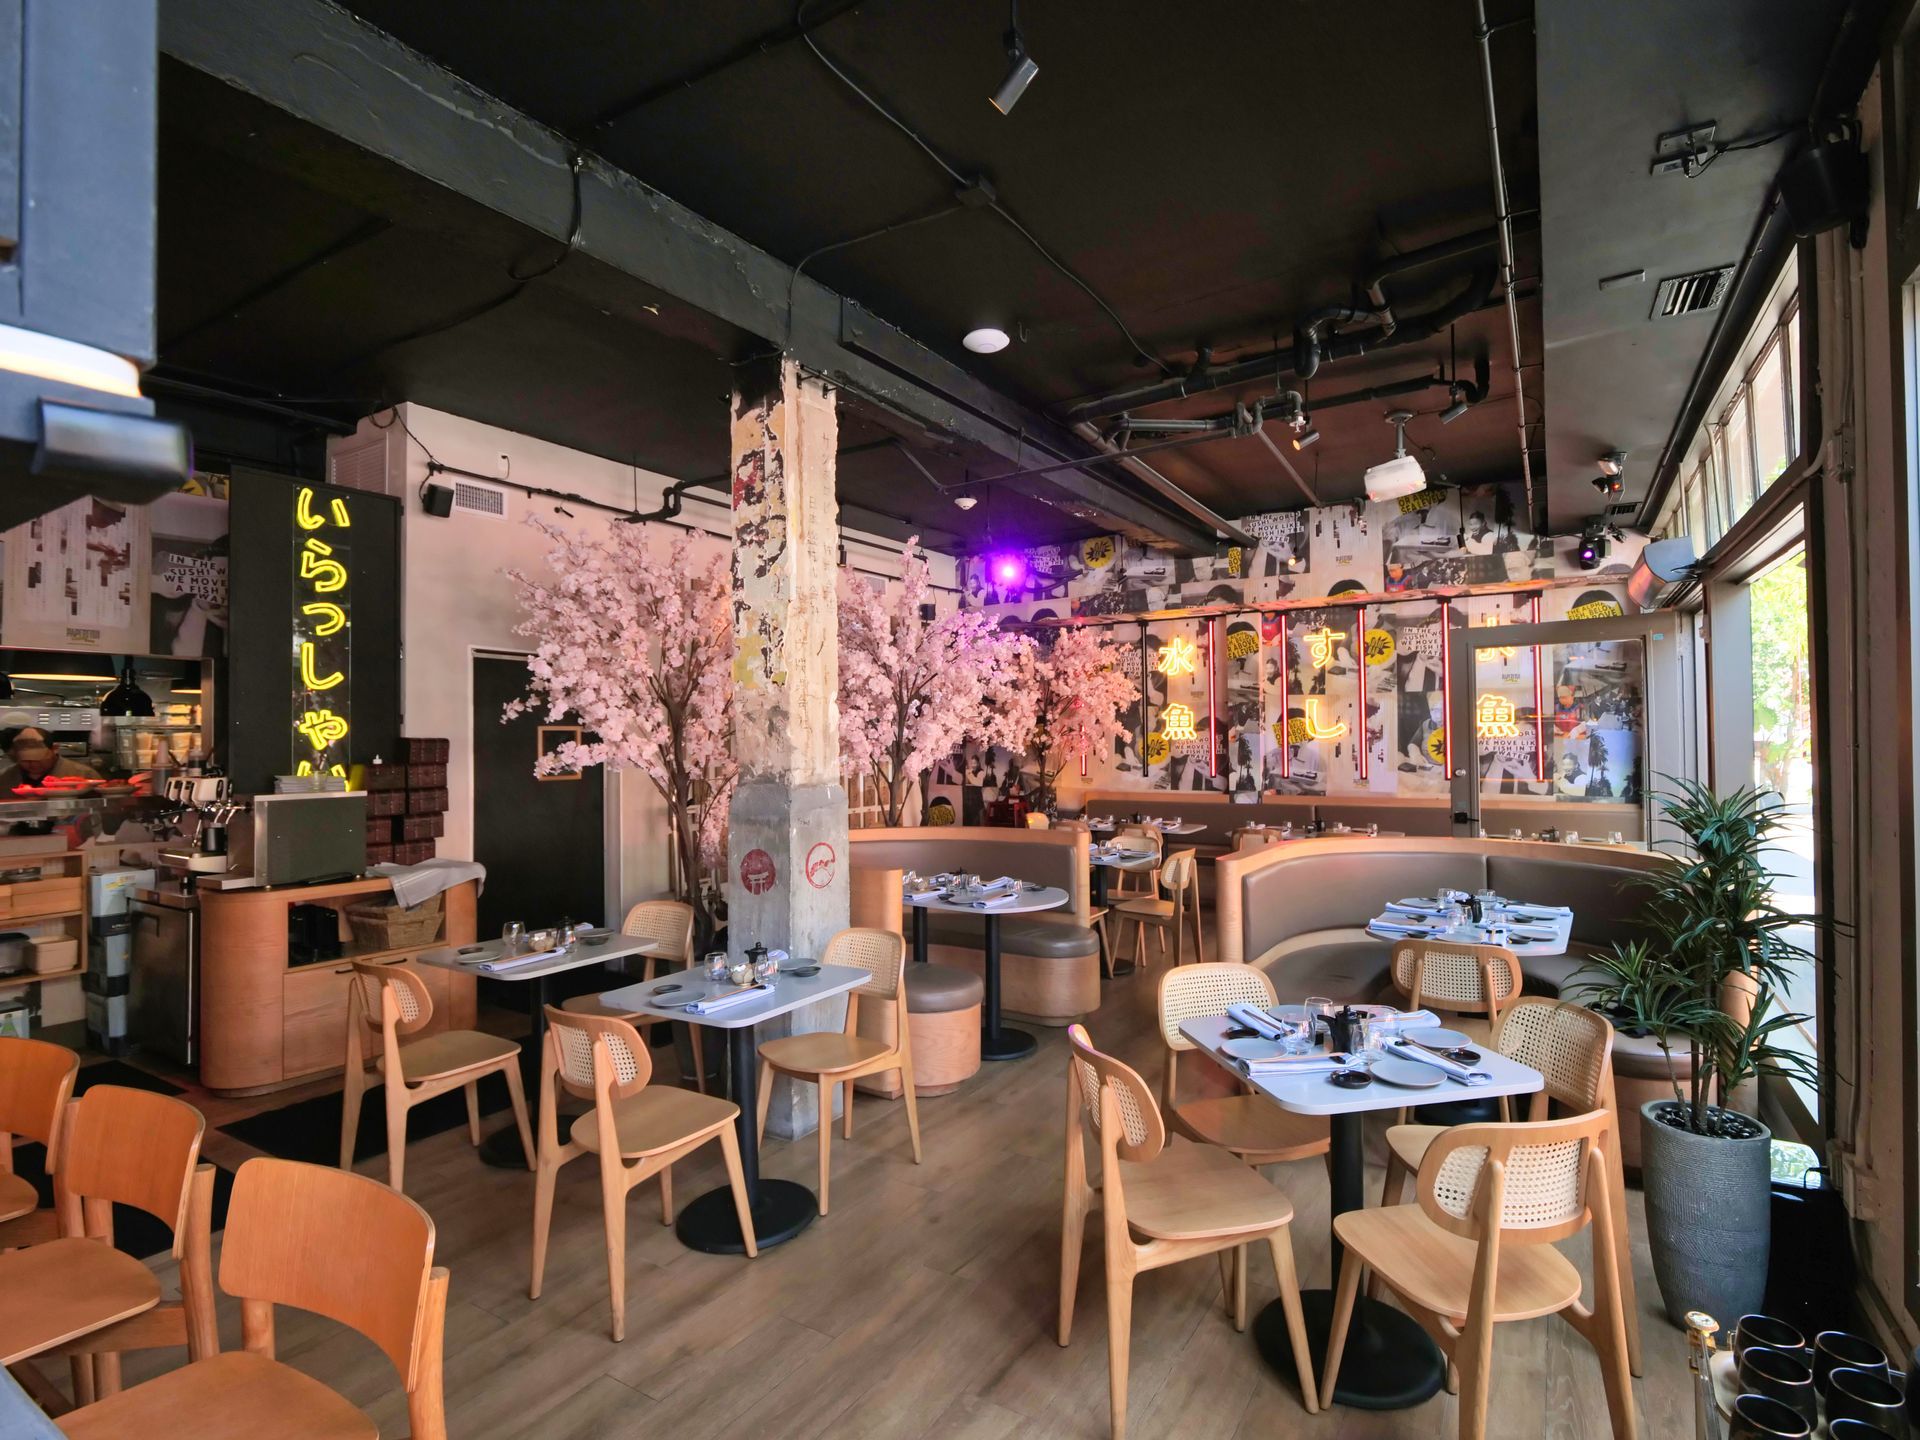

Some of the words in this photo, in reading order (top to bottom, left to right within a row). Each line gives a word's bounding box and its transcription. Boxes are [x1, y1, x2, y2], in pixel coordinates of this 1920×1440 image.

[170, 555, 184, 564] IN
[191, 559, 216, 570] THE
[164, 575, 184, 583] WE
[191, 578, 226, 586] MOVE
[190, 586, 218, 594] FISH
[1158, 637, 1197, 740] 水魚
[1303, 628, 1347, 739] すし
[1500, 751, 1528, 760] WATER
